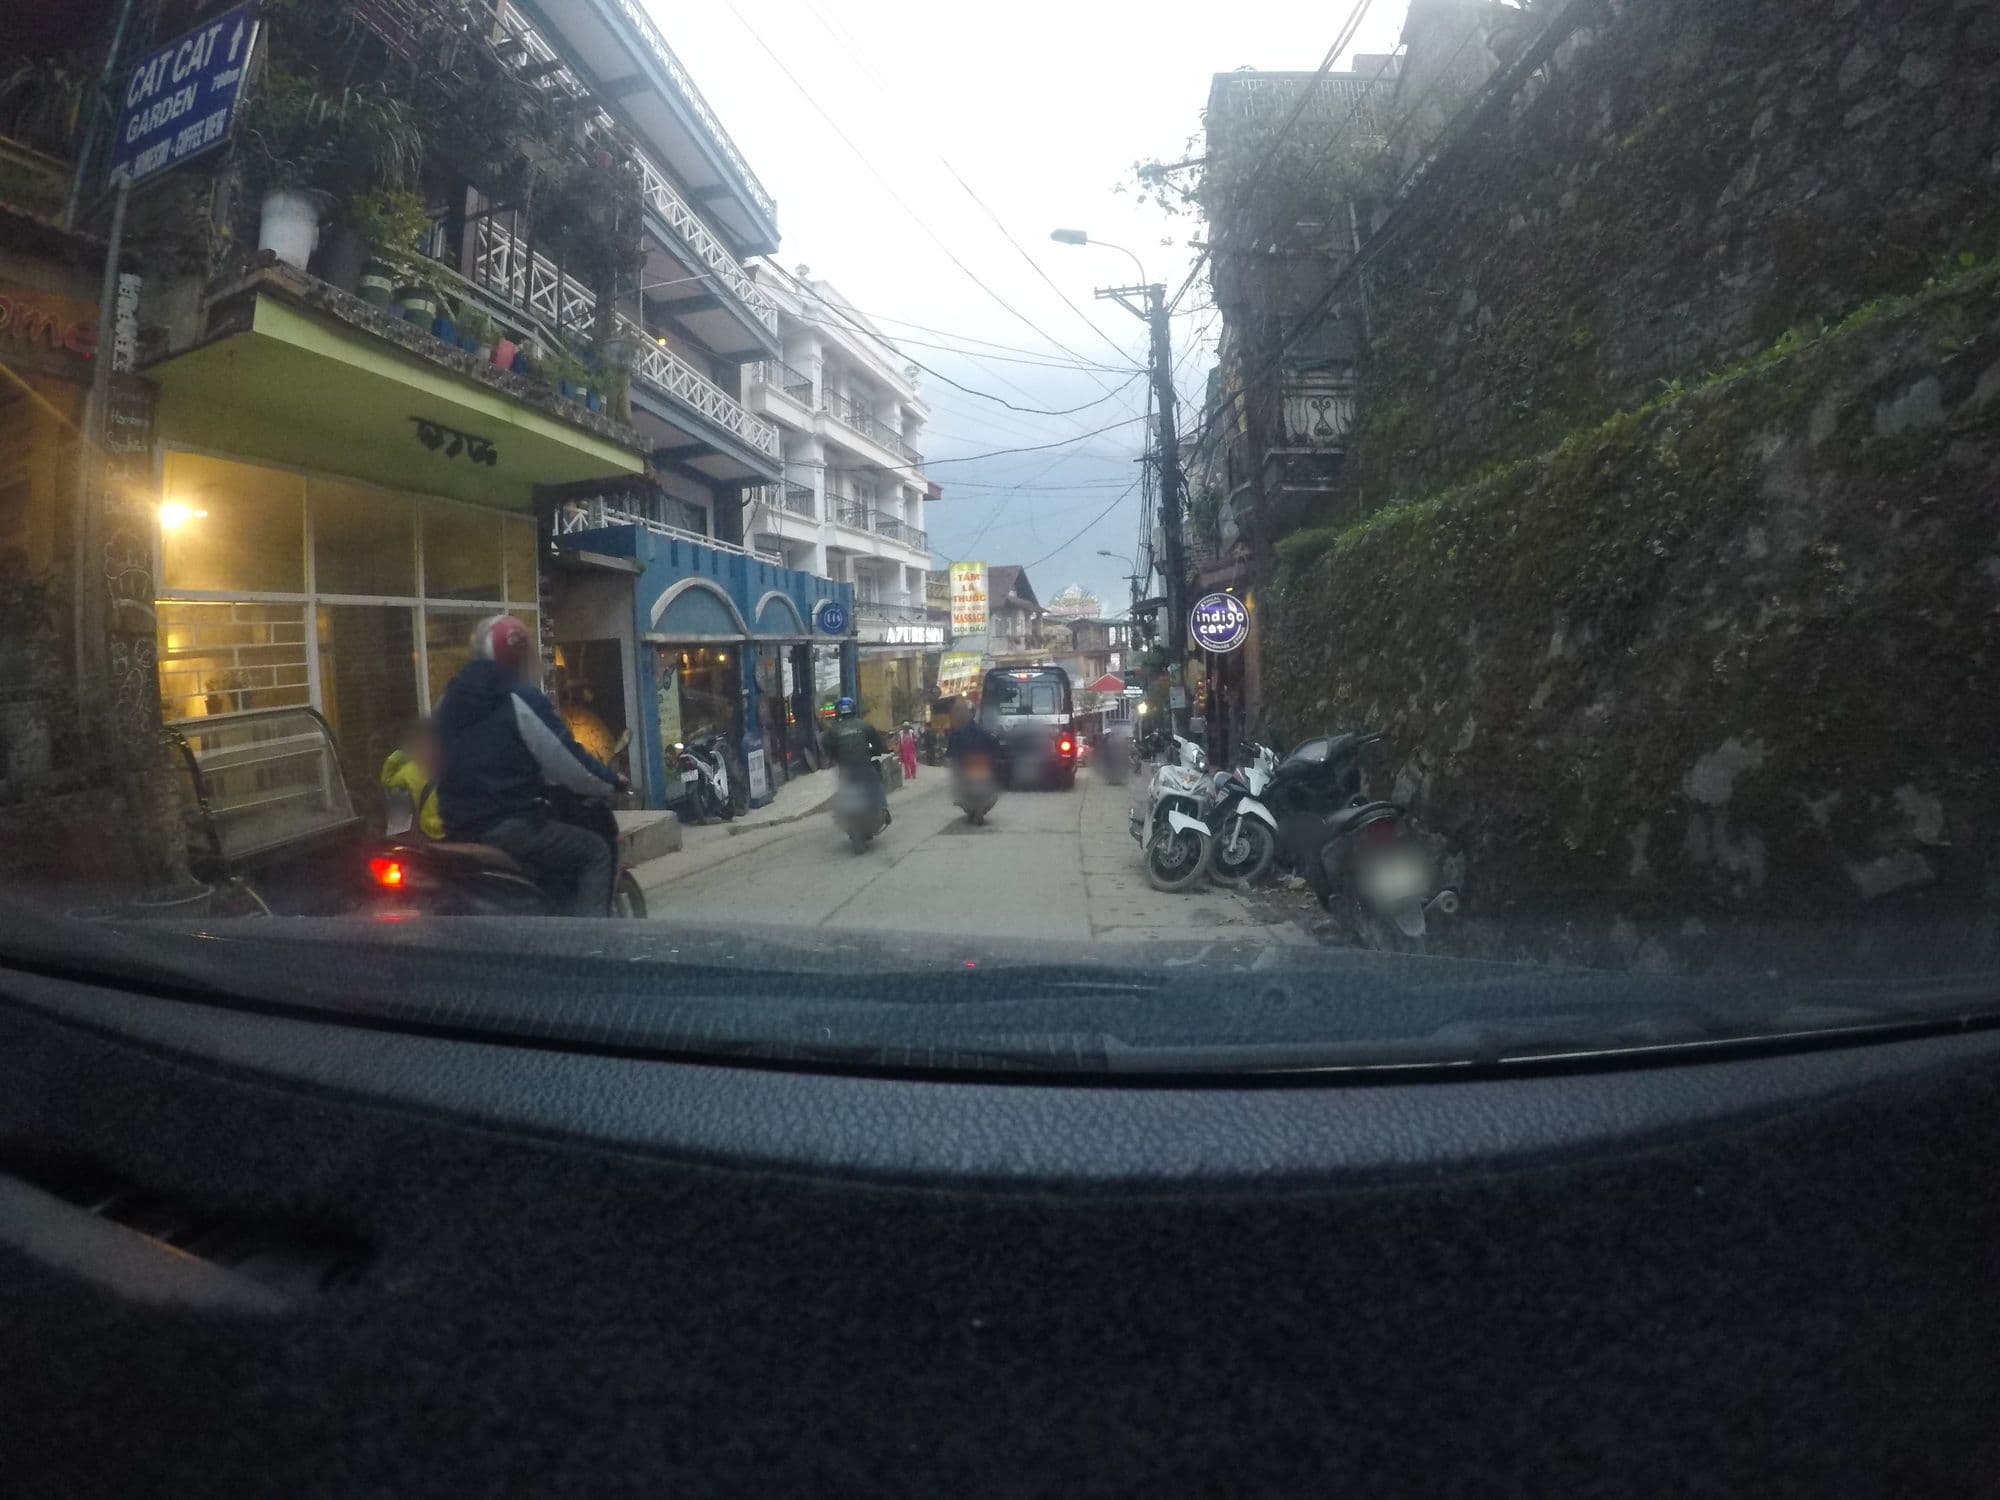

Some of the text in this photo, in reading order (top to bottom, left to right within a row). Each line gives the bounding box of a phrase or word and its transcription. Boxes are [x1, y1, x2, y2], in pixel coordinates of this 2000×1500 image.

[127, 23, 224, 109] CAT CAT
[126, 83, 198, 143] GARDEN
[174, 119, 206, 157] COFFEE
[953, 613, 985, 623] MASSAGE
[1196, 610, 1244, 628] indigo
[1200, 624, 1225, 634] cat
